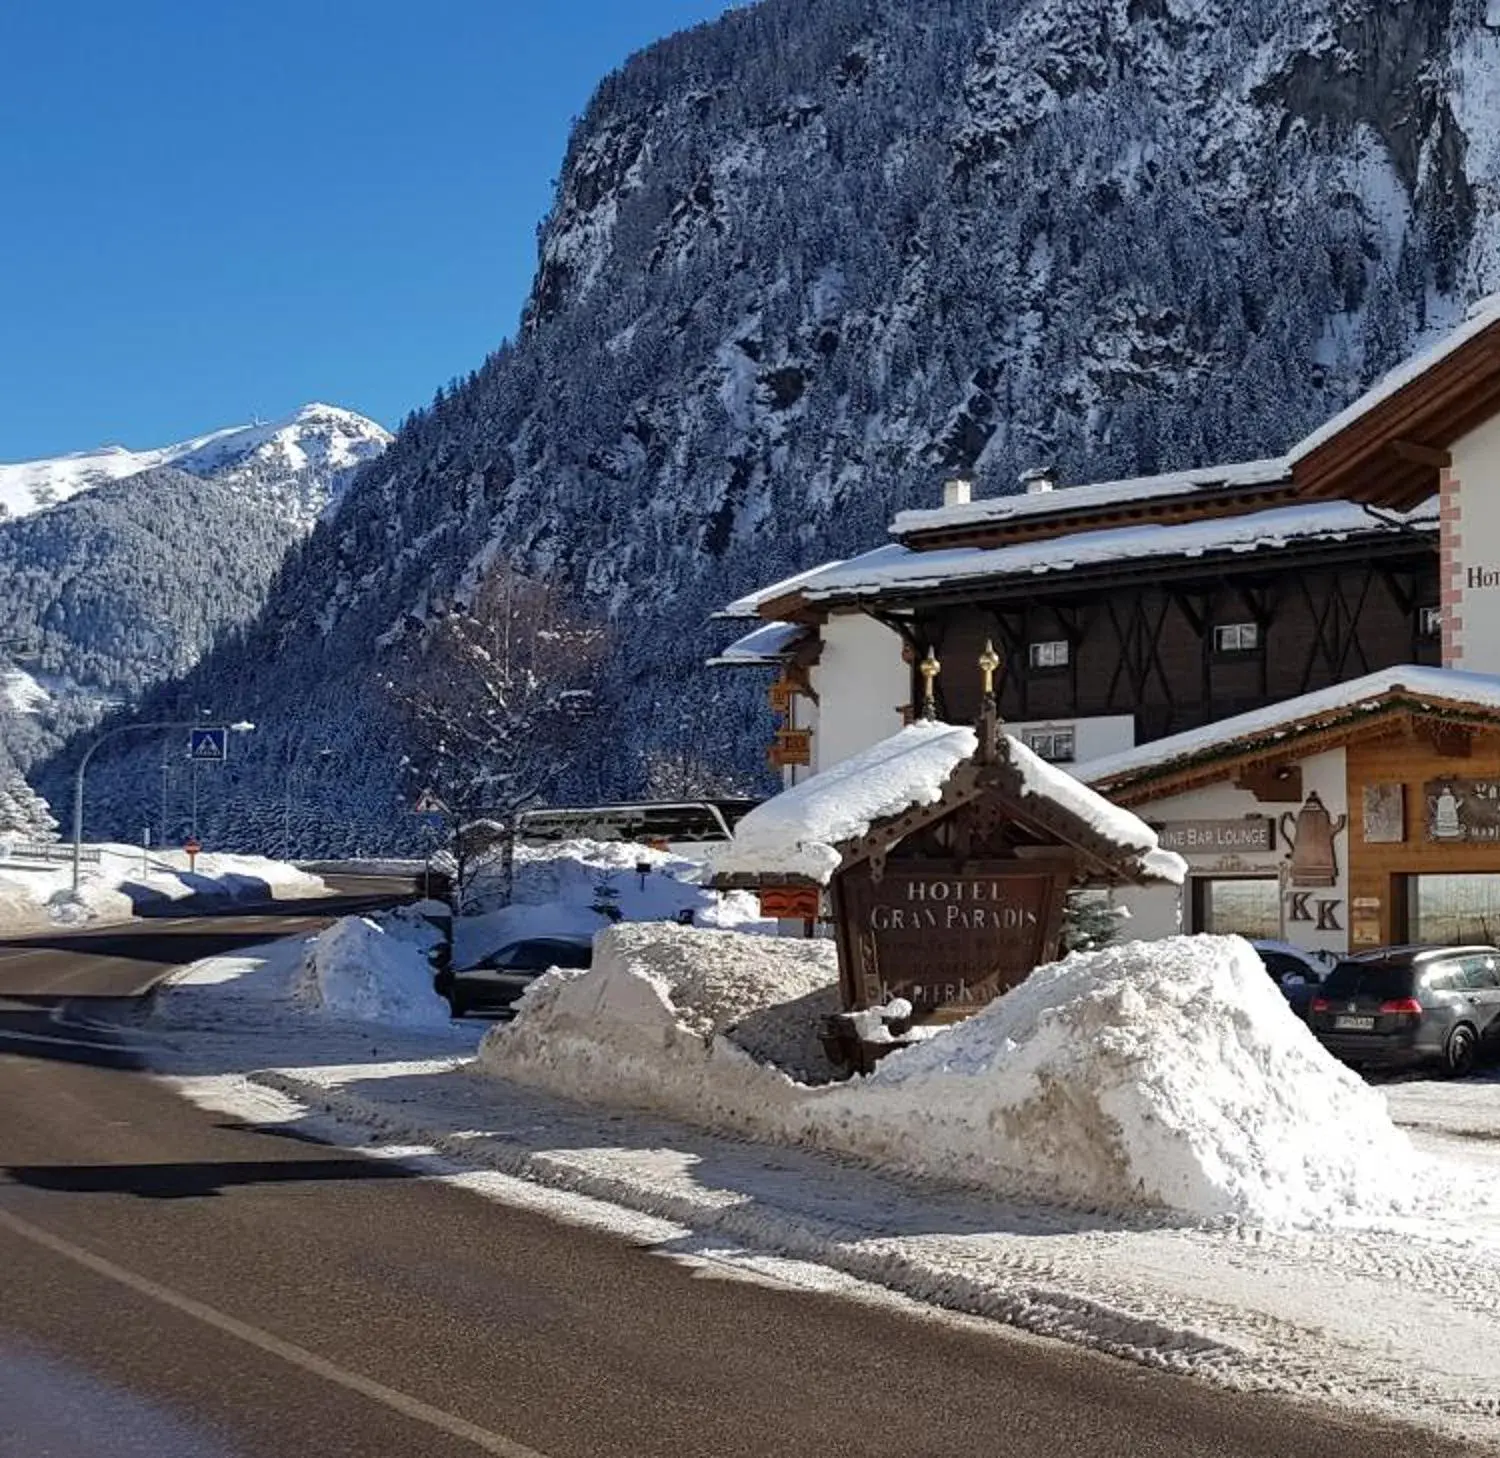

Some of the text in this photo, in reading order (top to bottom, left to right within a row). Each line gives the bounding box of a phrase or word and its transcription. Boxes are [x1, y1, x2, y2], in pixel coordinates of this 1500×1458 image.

[1187, 828, 1213, 845] BAR
[1217, 828, 1267, 845] LOUNGE
[907, 881, 1004, 901] HOTEL
[871, 904, 1037, 929] GRAN PARADIS
